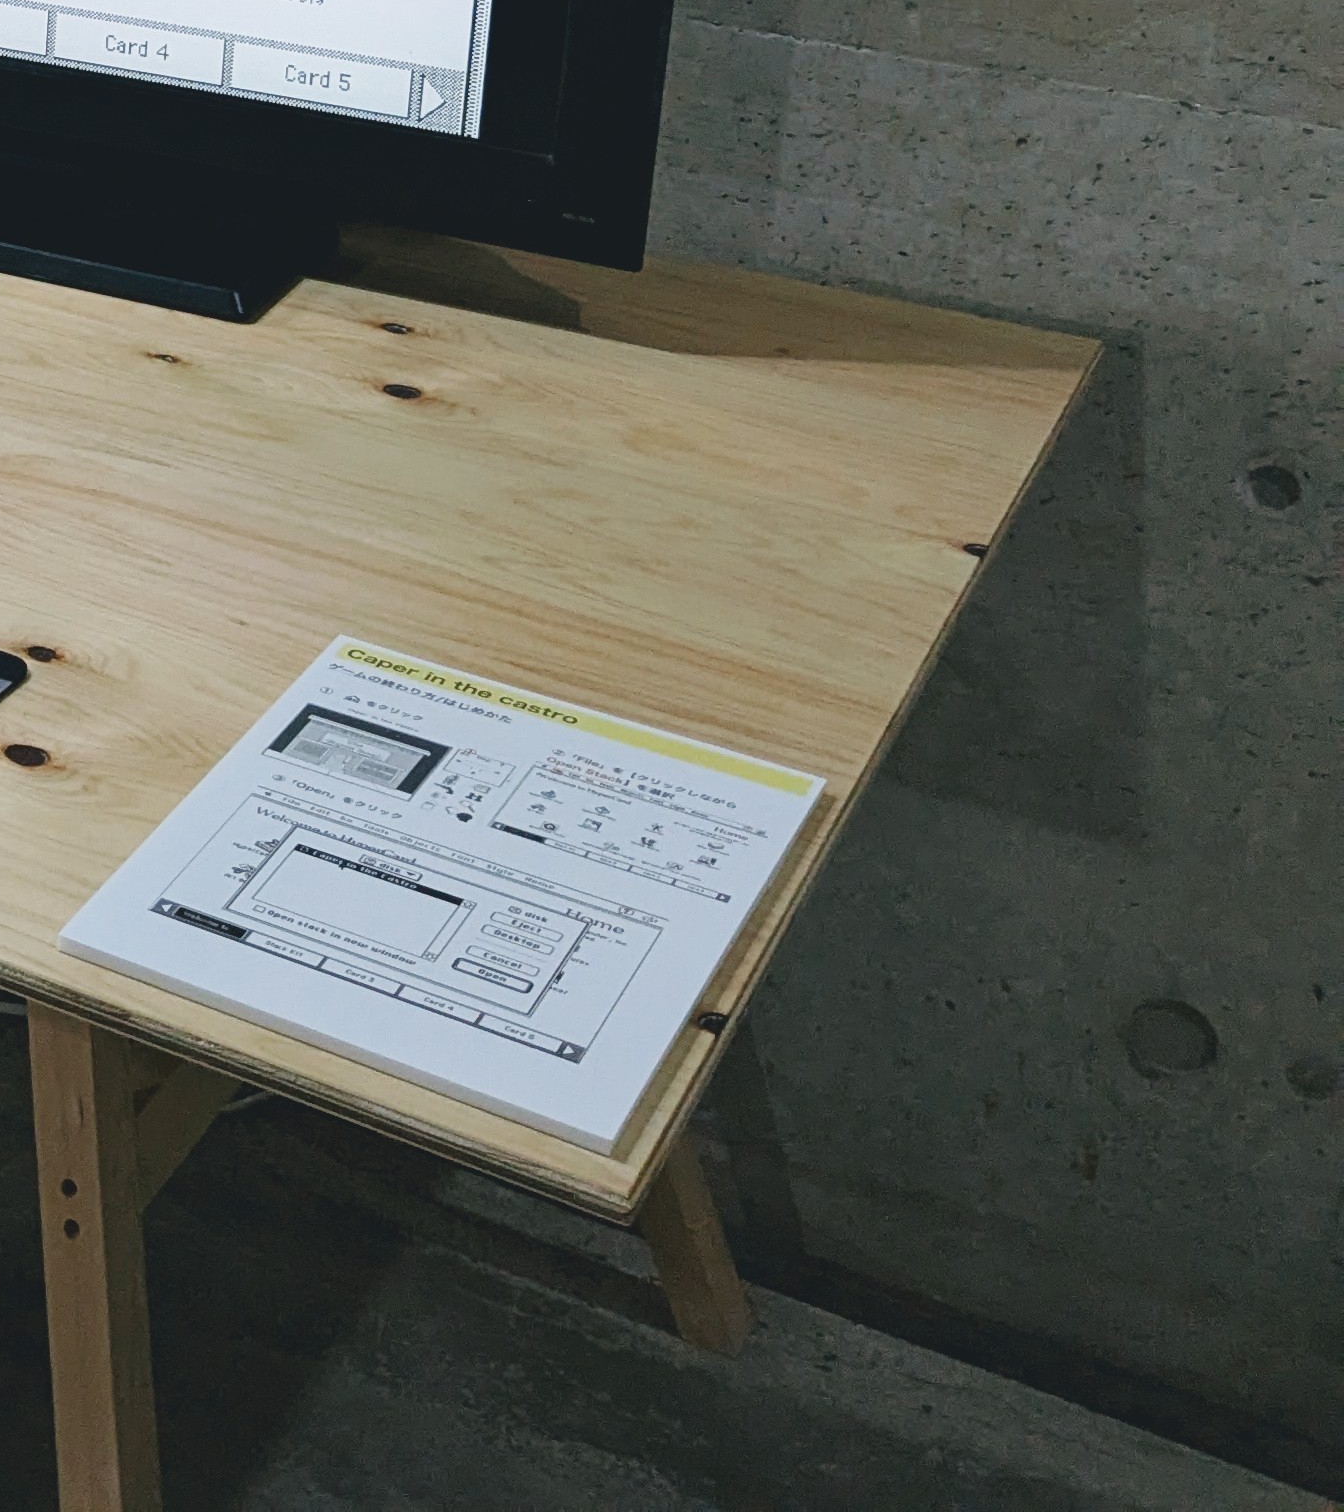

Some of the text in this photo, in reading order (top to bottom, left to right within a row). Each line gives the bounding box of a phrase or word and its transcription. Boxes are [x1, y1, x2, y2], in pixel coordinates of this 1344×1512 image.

[105, 34, 170, 61] Card 4
[284, 64, 352, 92] Card 5
[347, 649, 578, 725] Caper in the castro
